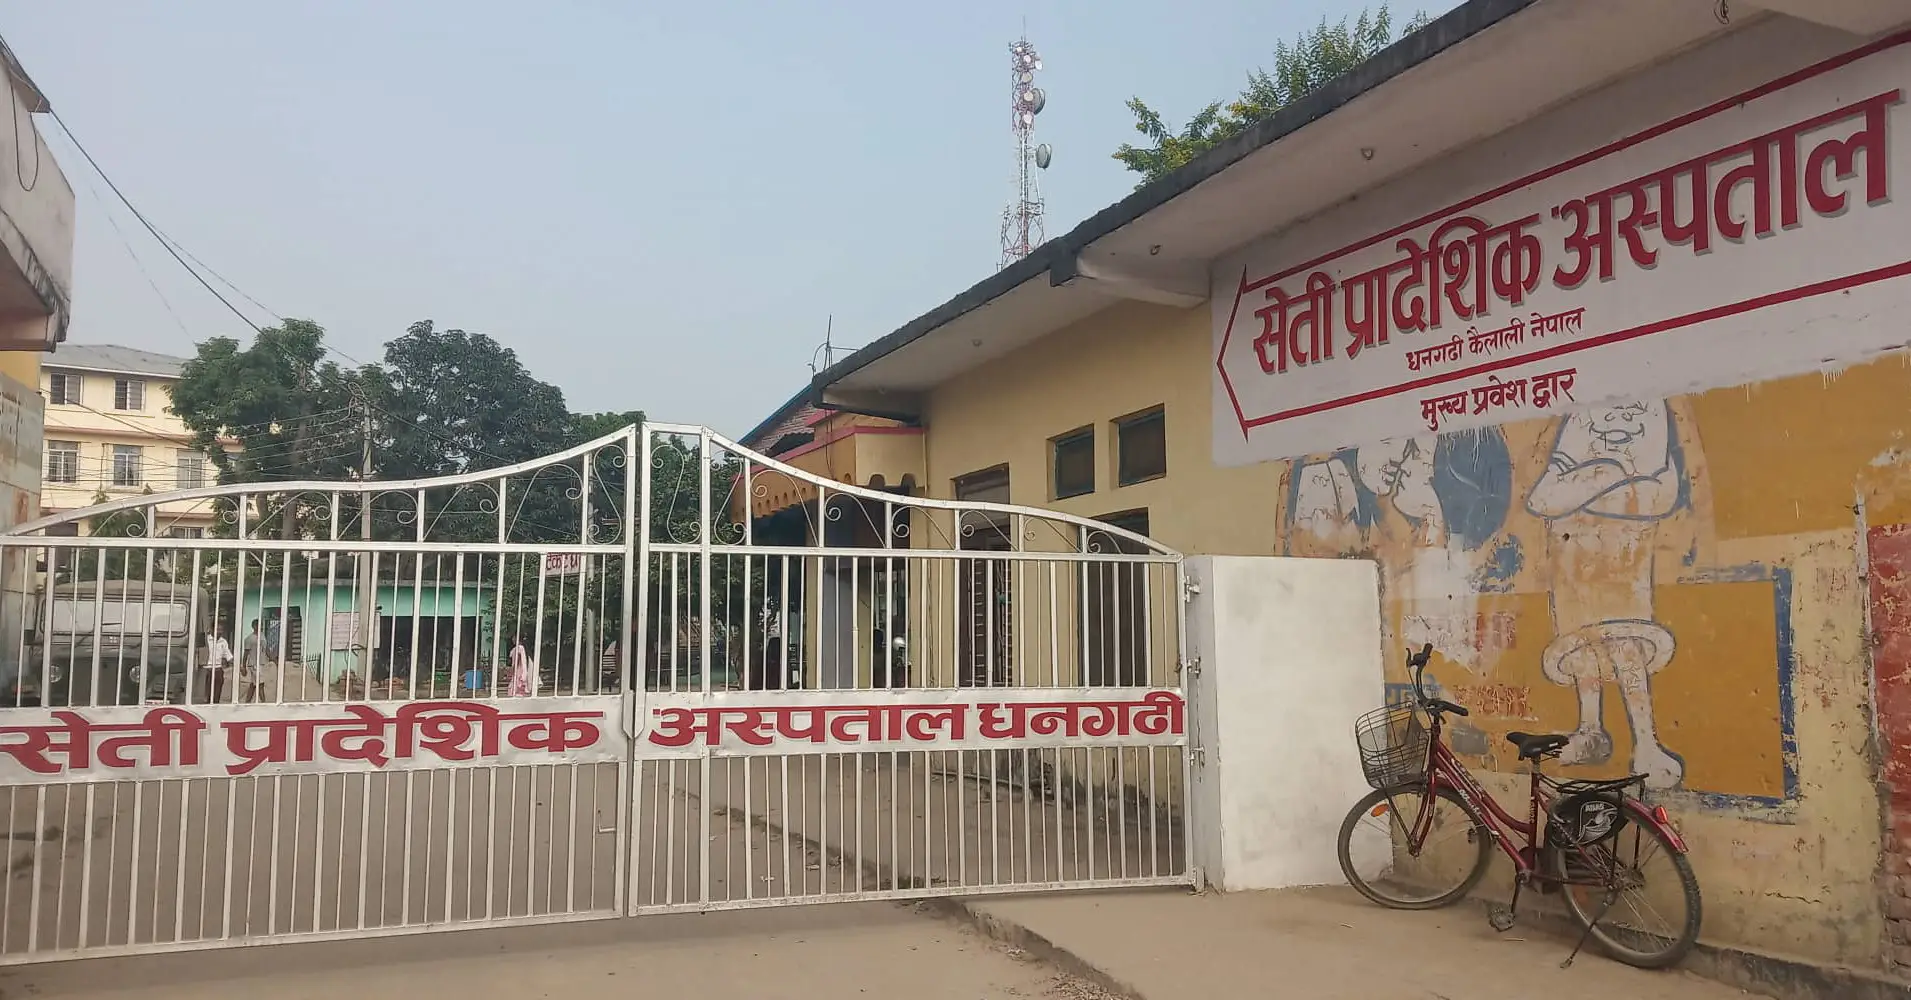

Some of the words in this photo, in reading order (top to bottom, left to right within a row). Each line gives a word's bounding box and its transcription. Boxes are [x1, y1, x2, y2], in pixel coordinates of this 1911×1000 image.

[1253, 272, 1337, 374] सेती
[1340, 215, 1542, 360] प्रादेशिक
[1550, 88, 1903, 291] अस्पताल
[1405, 334, 1464, 371] धनगढी
[1467, 317, 1526, 356] कैलाली
[1530, 306, 1587, 339] नेपाल
[1420, 390, 1468, 432] मुख्य
[1471, 374, 1528, 416] प्रवेश
[1531, 367, 1578, 409] द्वार
[0, 708, 207, 775] सेती
[220, 701, 604, 775] प्रादेशिक
[648, 703, 970, 747] अस्पताल
[976, 690, 1186, 739] धनगढी
